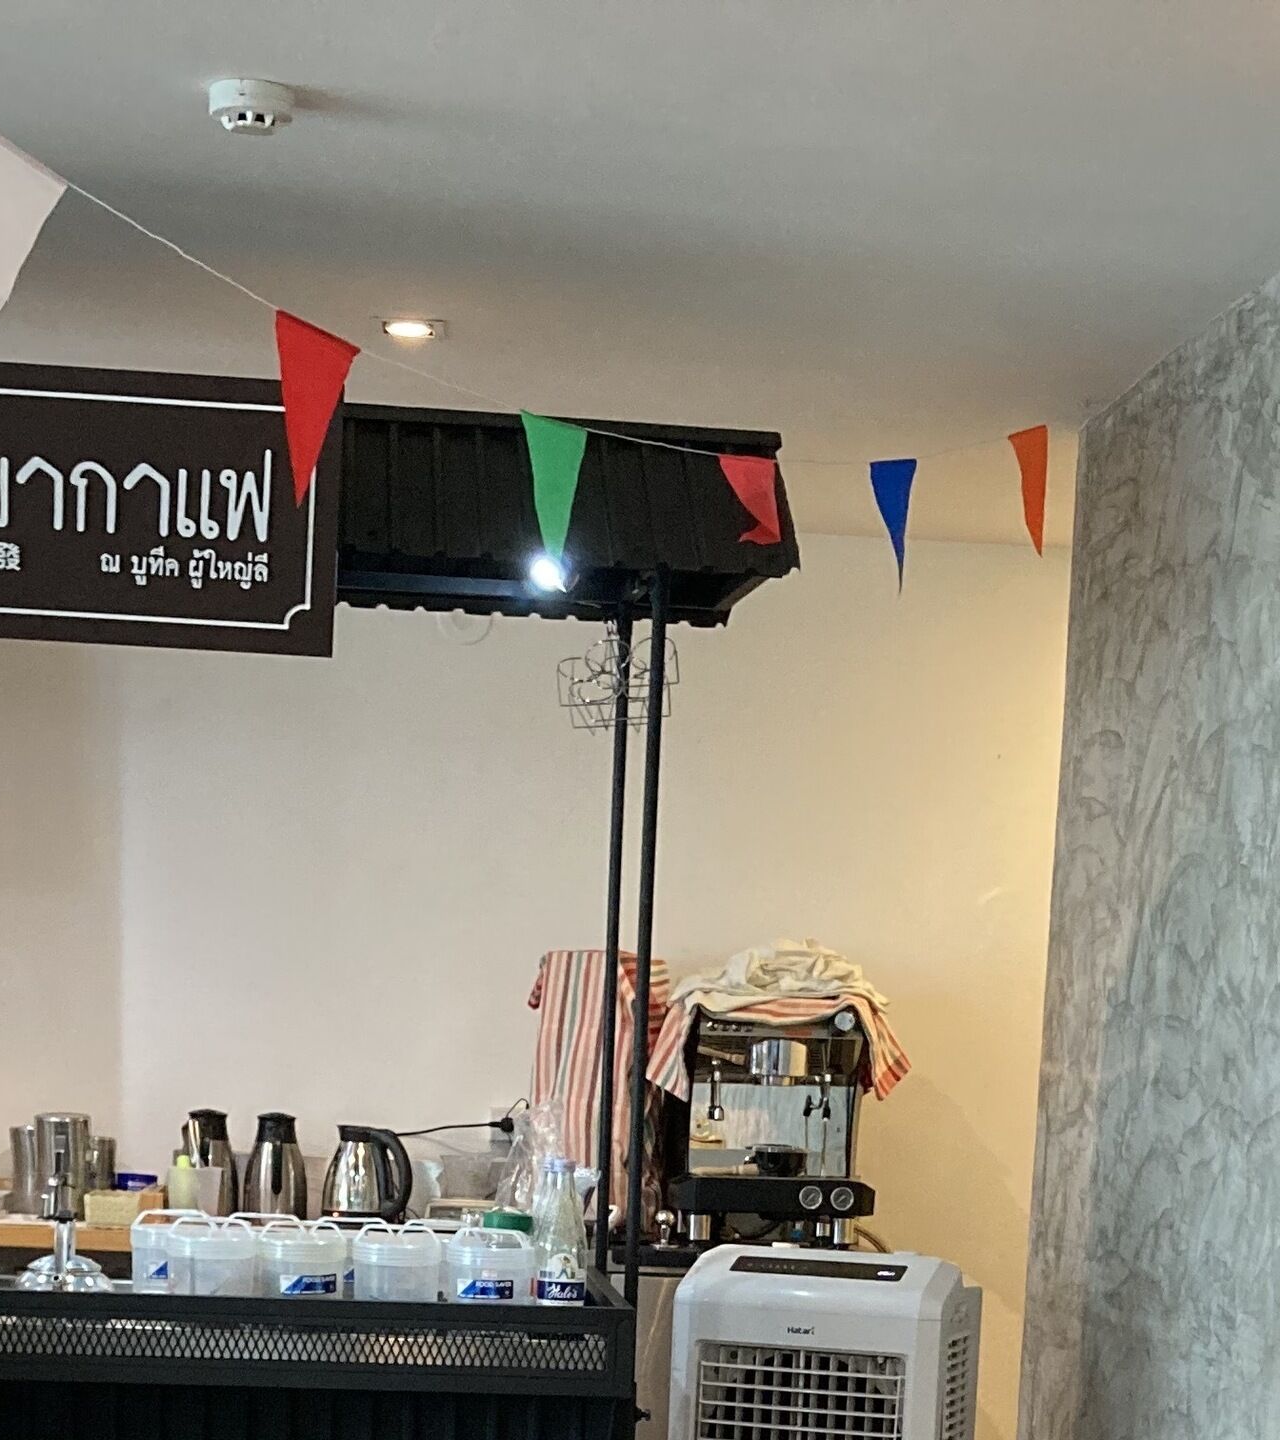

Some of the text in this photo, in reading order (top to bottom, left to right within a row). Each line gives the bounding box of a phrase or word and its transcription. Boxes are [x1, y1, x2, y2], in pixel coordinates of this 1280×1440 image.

[100, 547, 269, 589] ณ บูทีค ผู้ใหญ่ลี
